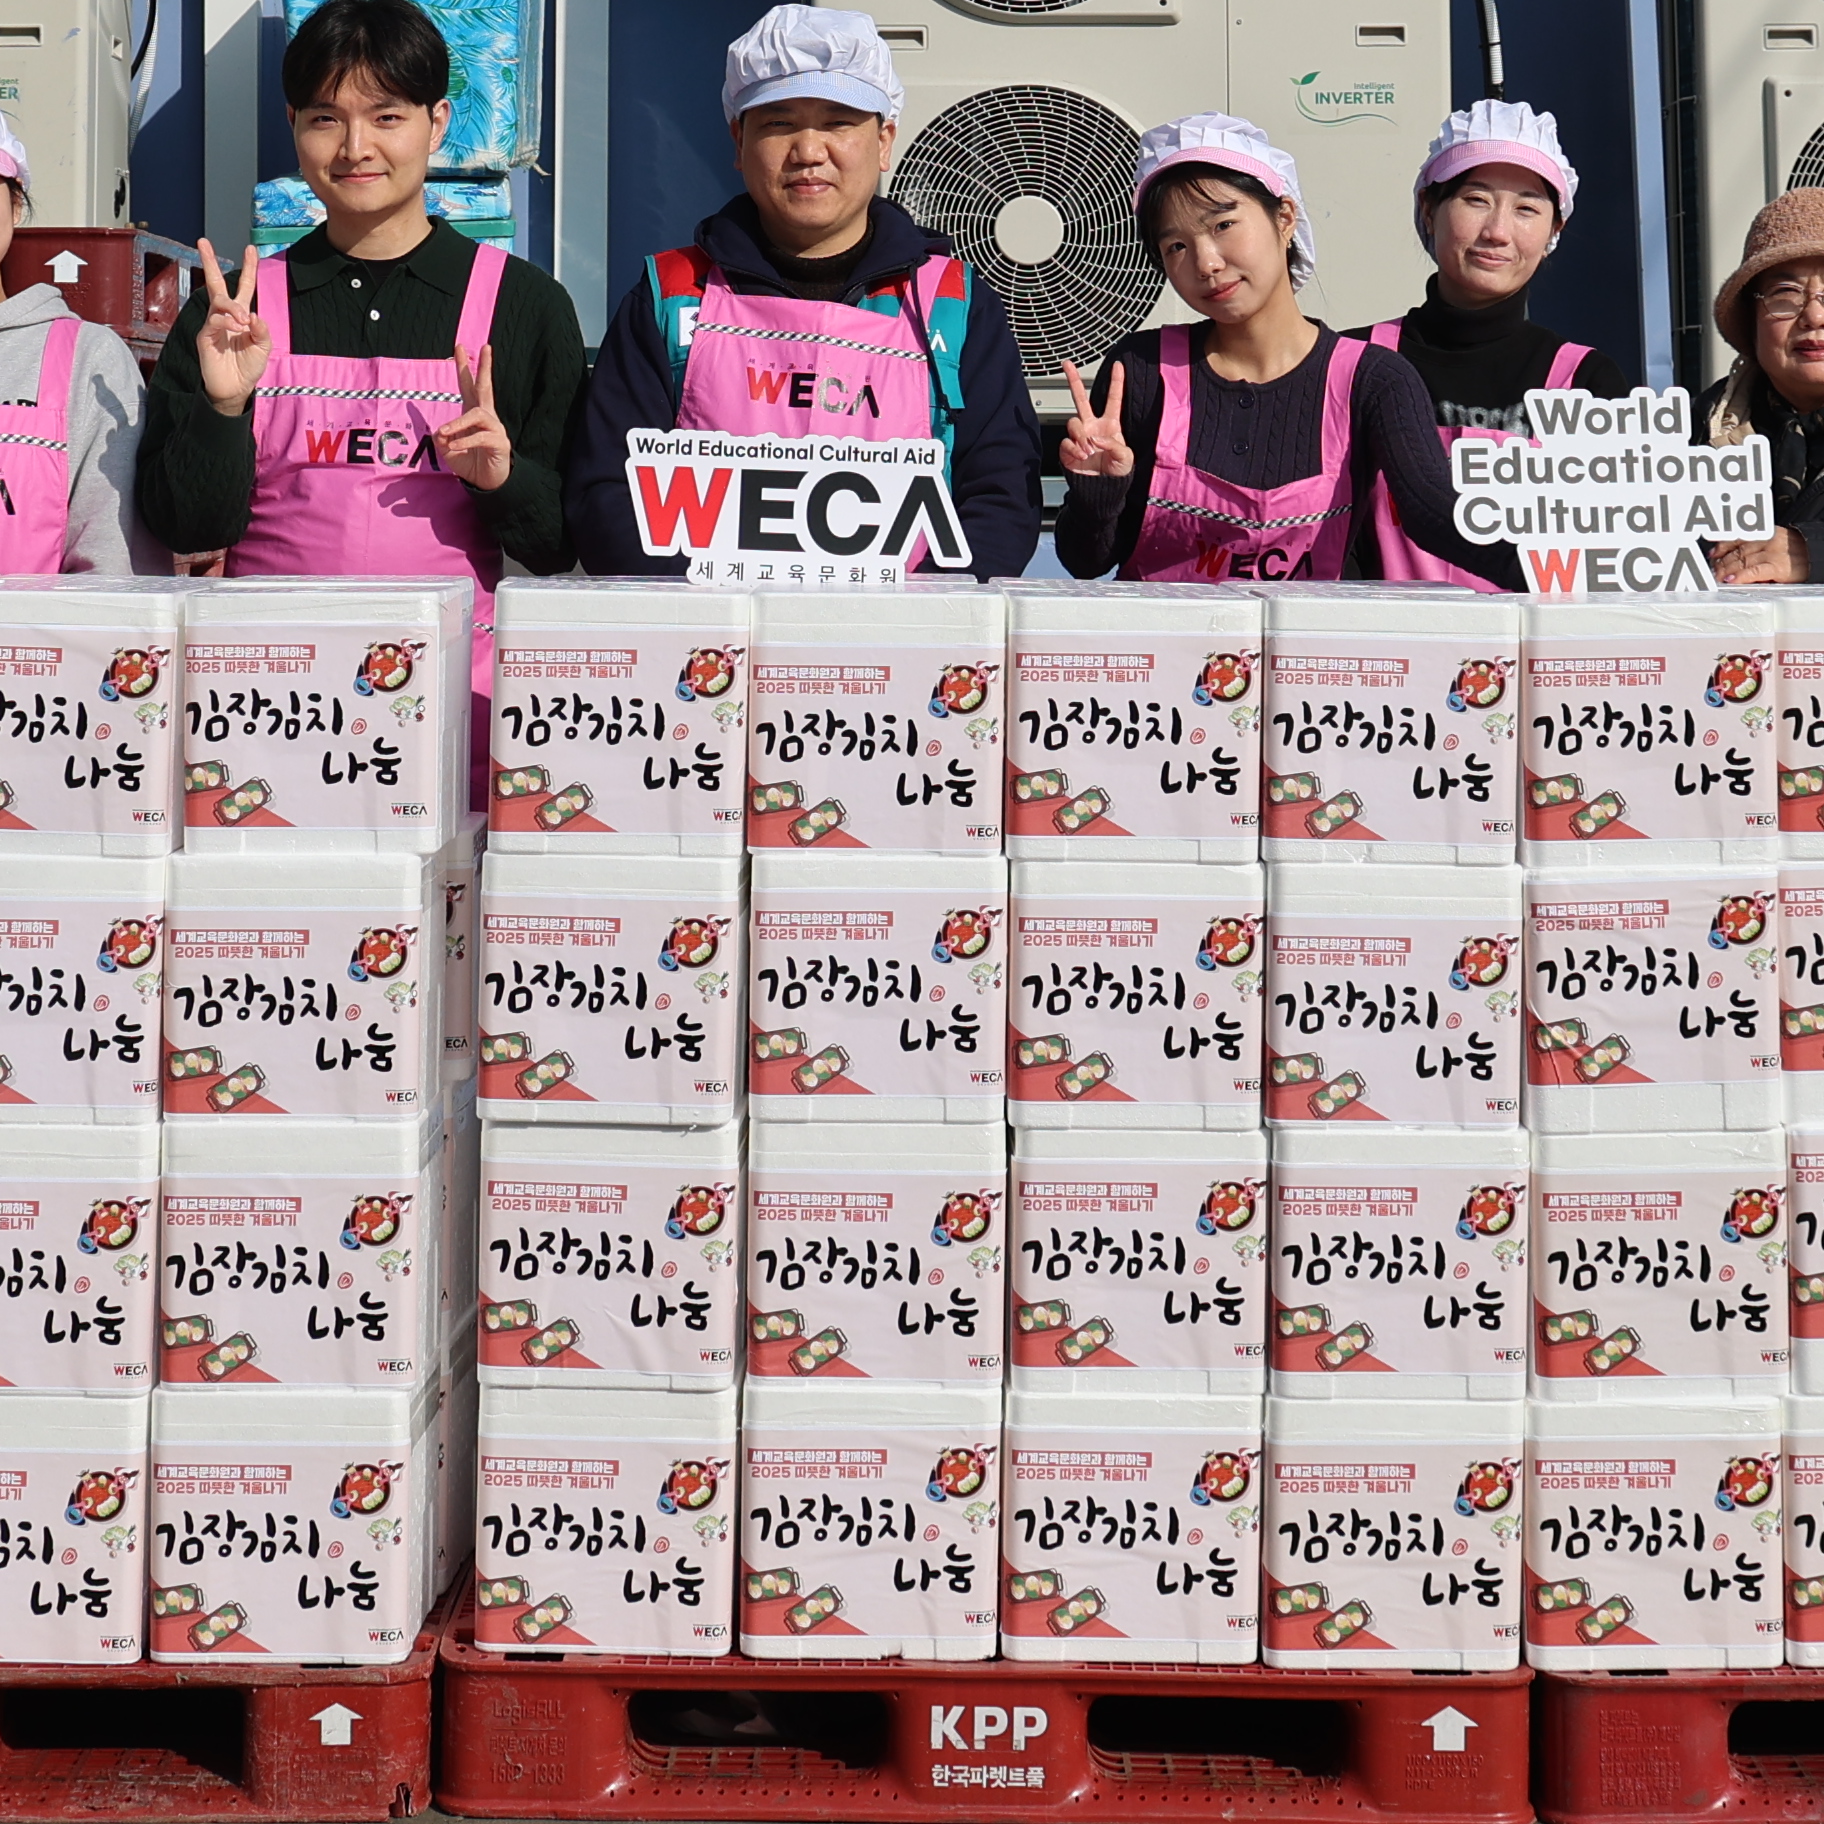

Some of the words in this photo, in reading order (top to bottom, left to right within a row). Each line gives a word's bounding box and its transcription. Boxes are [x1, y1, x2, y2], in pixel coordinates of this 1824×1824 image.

[1314, 91, 1395, 105] INVERTER
[1353, 81, 1395, 92] Intelligent
[746, 367, 881, 418] WECA
[1534, 396, 1682, 436] World
[305, 428, 441, 471] WECA
[635, 437, 693, 457] World
[697, 439, 816, 461] Educational
[818, 443, 898, 464] Cultural
[902, 446, 936, 465] Aid
[1459, 444, 1764, 486] Educational
[635, 465, 963, 559] WECA
[1463, 493, 1671, 535] Cultural
[1684, 494, 1767, 534] Aid
[1194, 540, 1314, 581] WECA
[1528, 546, 1710, 594] WECA
[758, 682, 795, 694] 2025
[1785, 668, 1821, 679] 2025
[756, 709, 917, 762] 김장김치
[897, 759, 976, 807] 나눔
[965, 827, 1001, 838] WECA
[1285, 1204, 1322, 1216] 2025
[1282, 1232, 1445, 1285] 김장김치
[1424, 1281, 1504, 1330] 나눔
[1494, 1351, 1525, 1361] WECA
[931, 1705, 1048, 1751] KPP
[931, 1764, 1046, 1789] 한국파렛트풀
